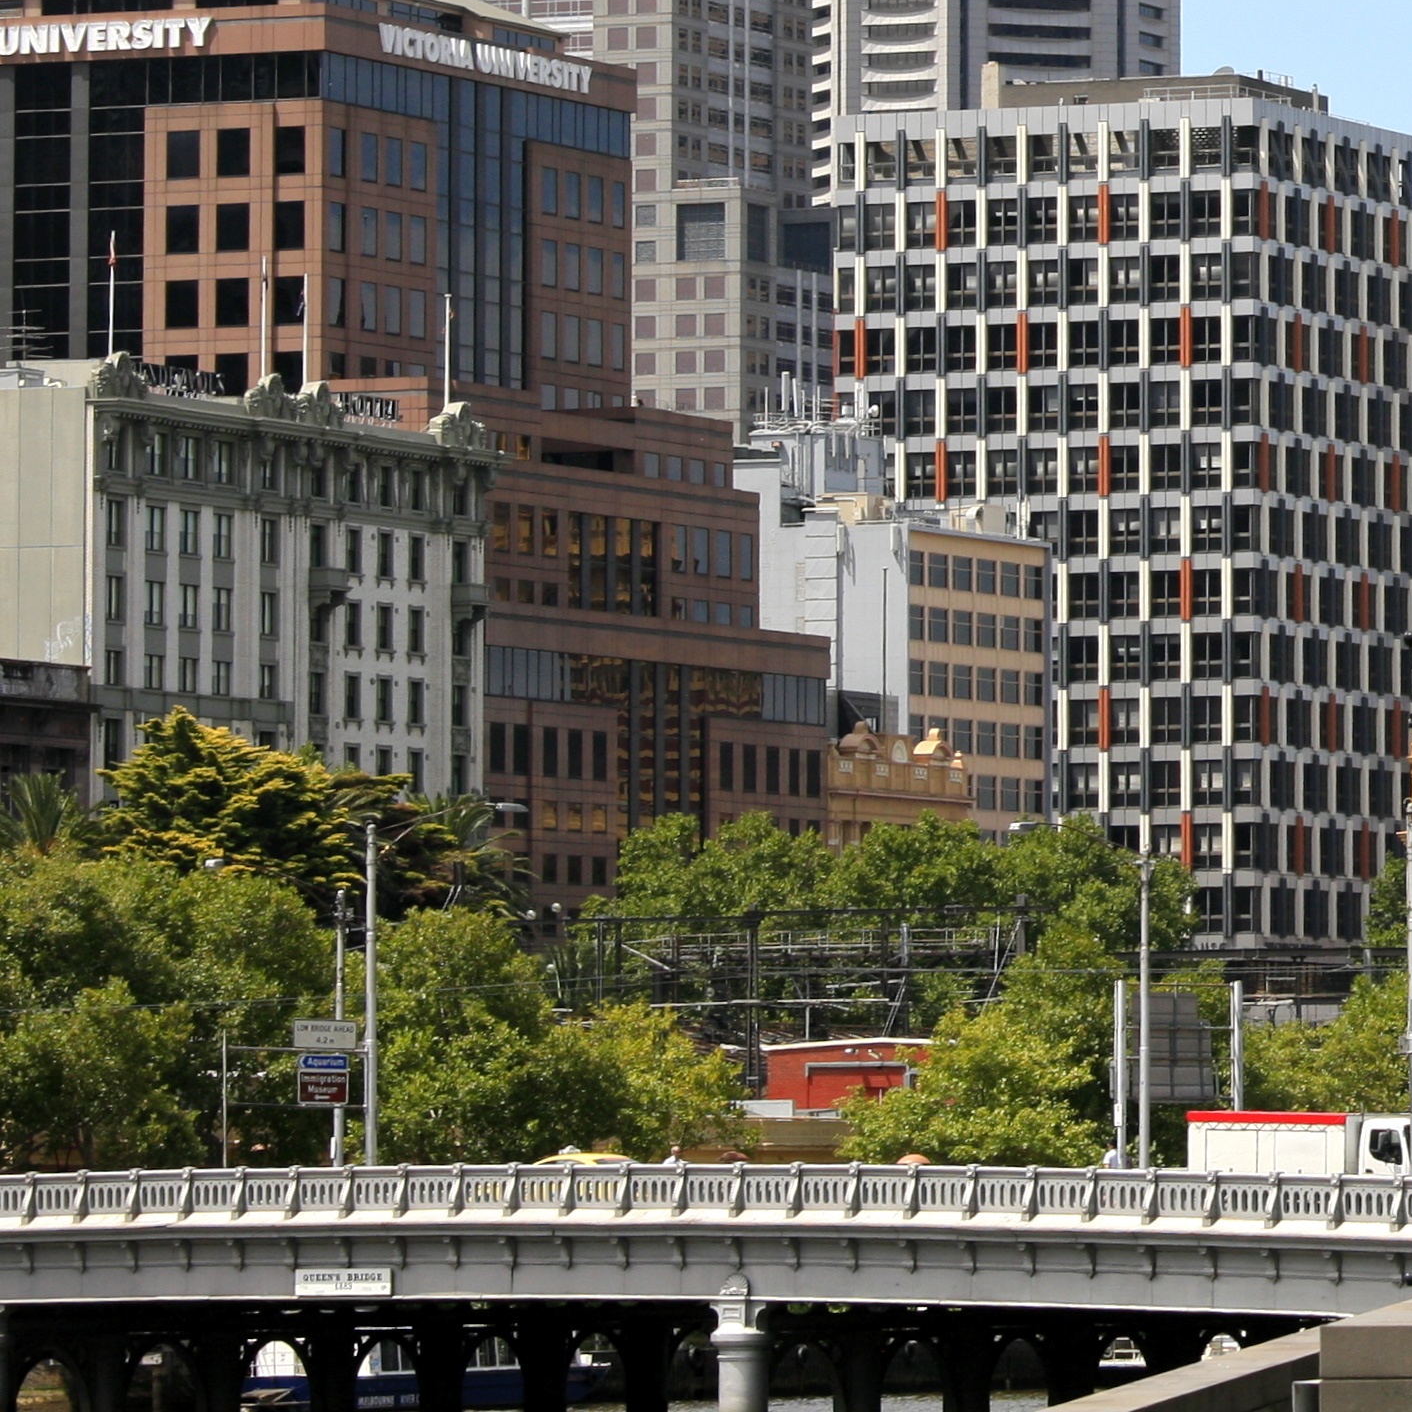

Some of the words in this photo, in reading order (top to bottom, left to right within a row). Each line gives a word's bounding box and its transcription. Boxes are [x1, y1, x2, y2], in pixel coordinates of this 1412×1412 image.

[0, 16, 214, 56] UNIVERSITY
[378, 22, 474, 70] VICTORIA
[475, 43, 592, 94] UNIVERSITY
[307, 1057, 345, 1067] Aquarium
[300, 1074, 346, 1085] Immigration
[308, 1084, 338, 1093] Museum
[303, 1273, 341, 1281] QUEEN'S
[347, 1273, 383, 1281] BRIDGE
[358, 1395, 395, 1406] MELBOURNE
